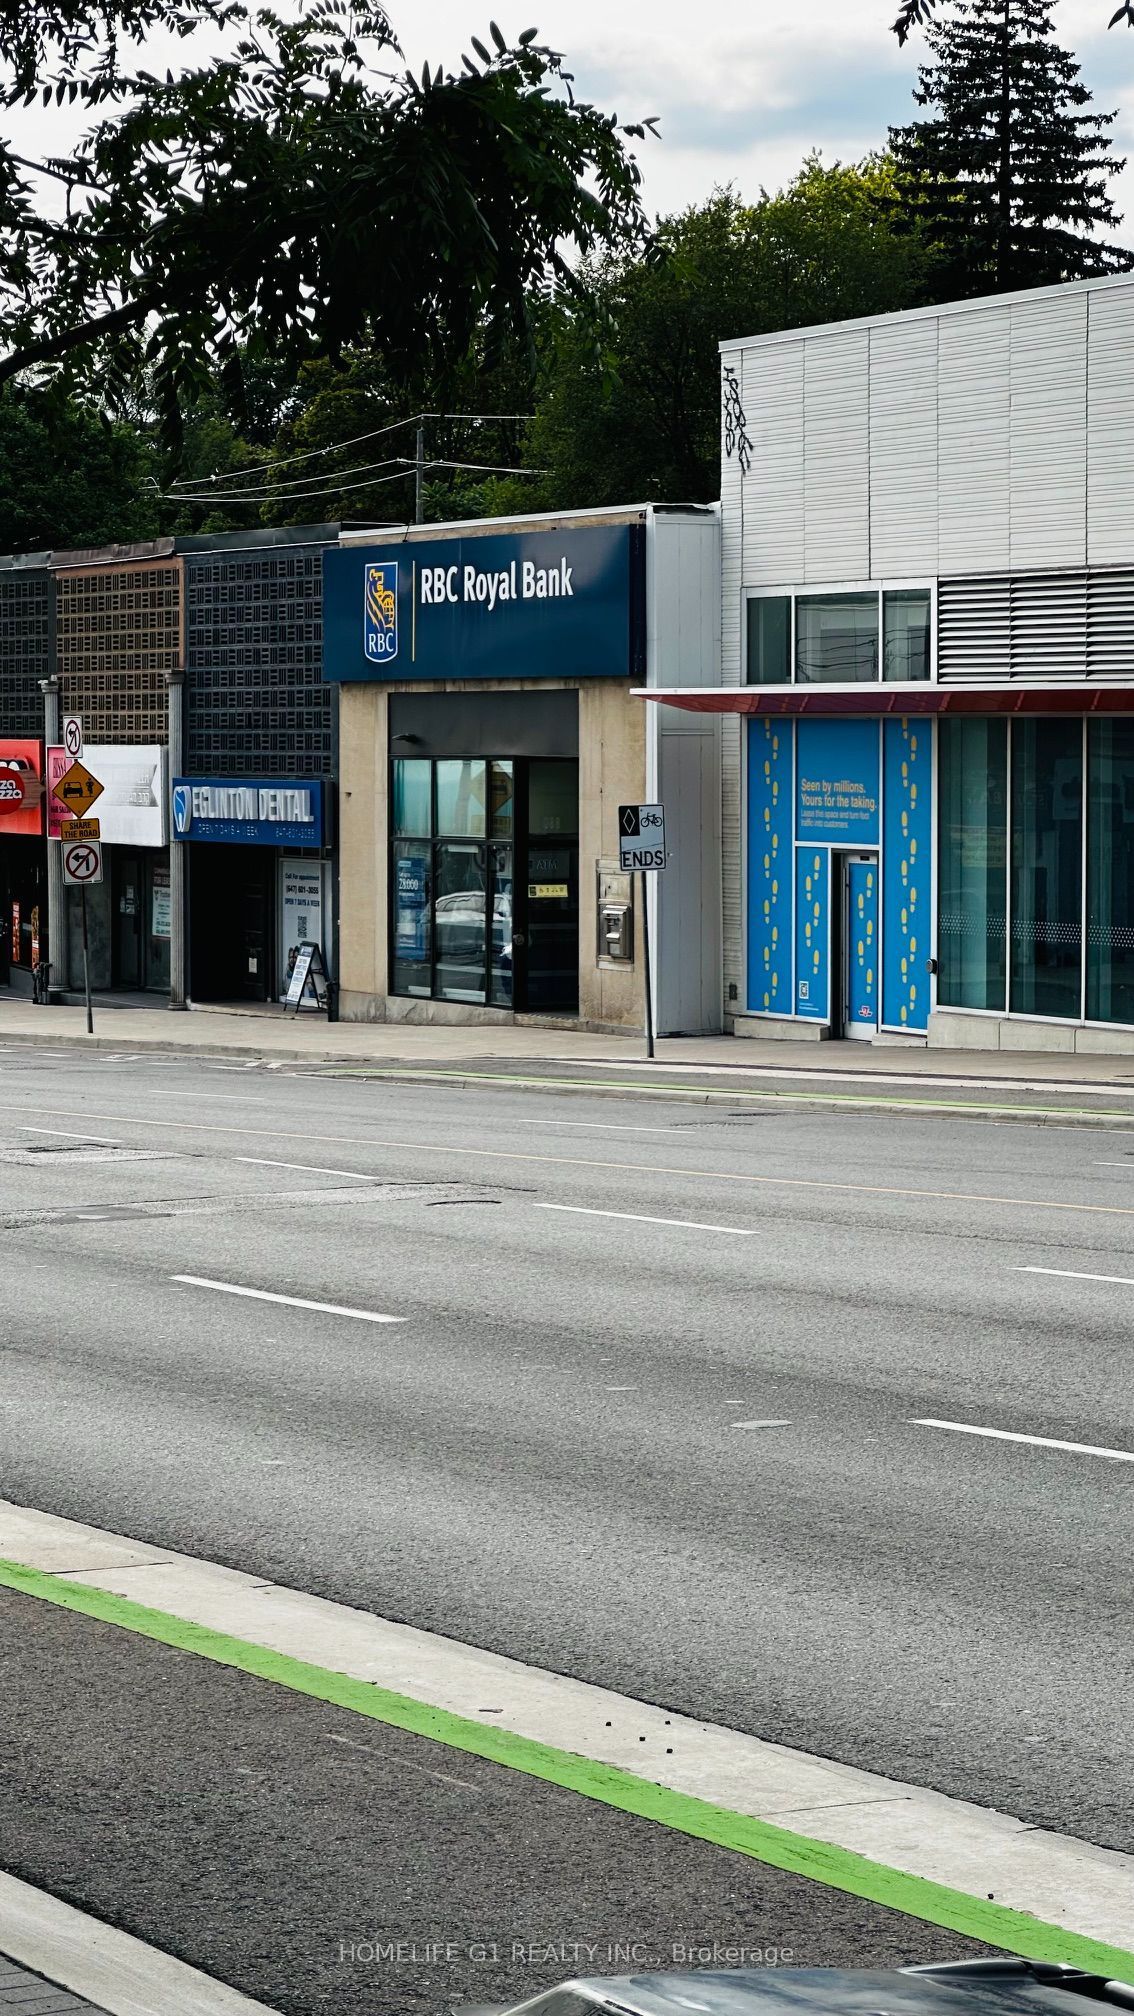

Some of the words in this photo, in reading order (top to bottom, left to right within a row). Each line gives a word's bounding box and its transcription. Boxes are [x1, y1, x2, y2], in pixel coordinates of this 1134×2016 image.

[420, 565, 459, 604] RBC
[463, 560, 518, 612] Royal
[522, 556, 574, 599] Bank
[368, 632, 395, 653] RBC
[801, 778, 820, 791] Seen
[822, 780, 832, 795] by
[833, 780, 867, 793] millions.
[192, 786, 258, 820] EGLINTON
[258, 788, 315, 822] DENTAL
[801, 793, 823, 806] Yours
[824, 794, 835, 807] for
[836, 794, 849, 808] the
[850, 796, 878, 812] taking.
[64, 830, 78, 838] THE
[79, 829, 98, 838] ROAD
[69, 821, 92, 830] SHARE
[622, 850, 664, 868] ENDS
